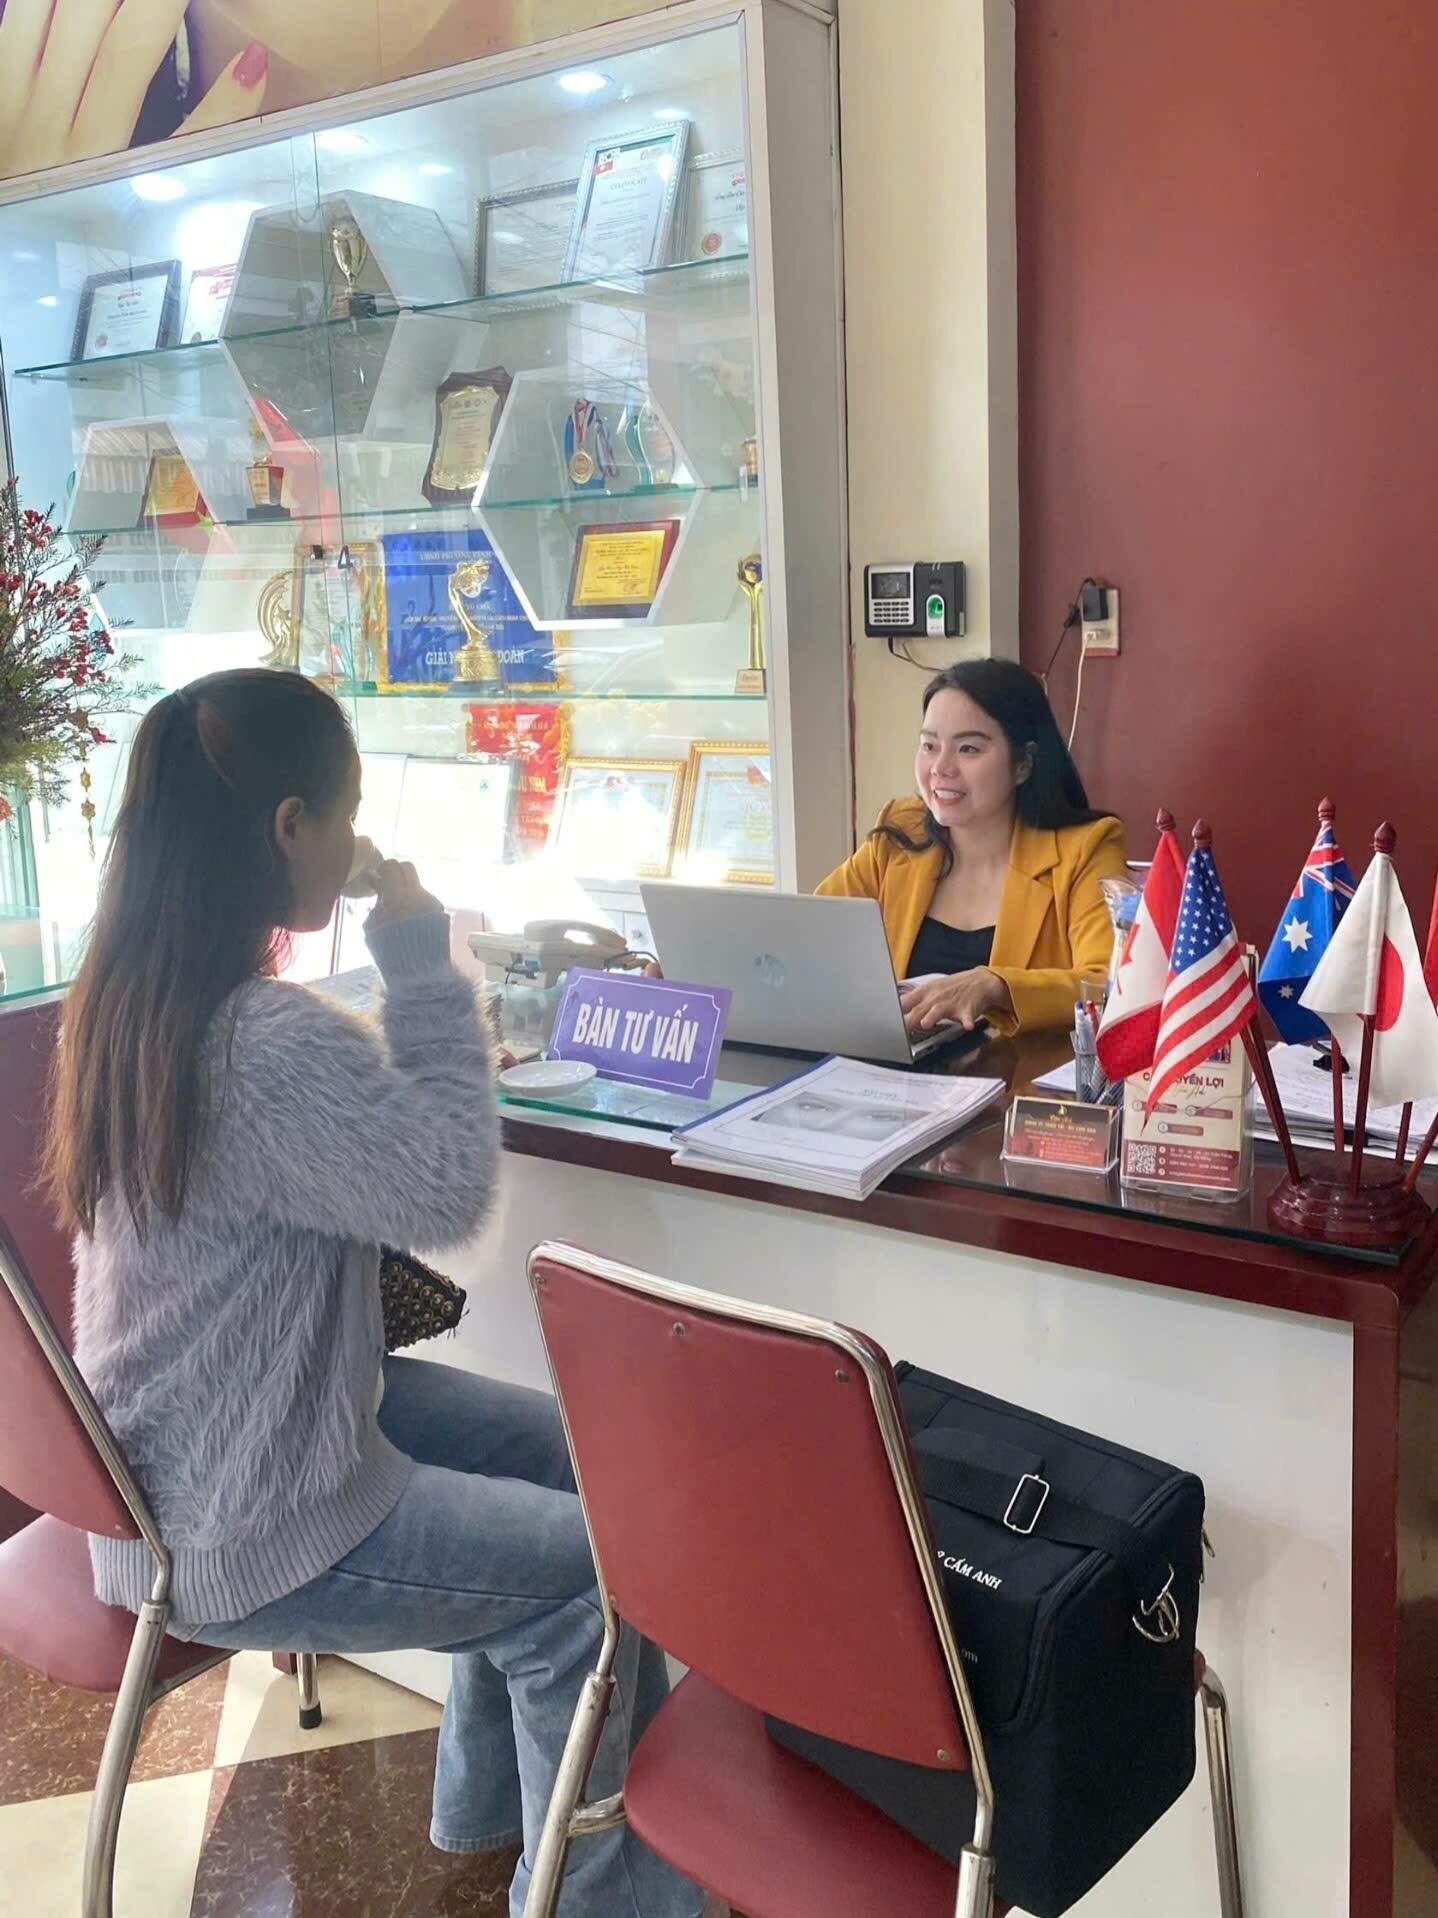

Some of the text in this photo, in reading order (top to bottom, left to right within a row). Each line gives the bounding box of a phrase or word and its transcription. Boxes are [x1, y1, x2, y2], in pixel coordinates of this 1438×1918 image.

[572, 997, 699, 1064] BÀN TƯ VẤN
[972, 1570, 1002, 1589] ANH
